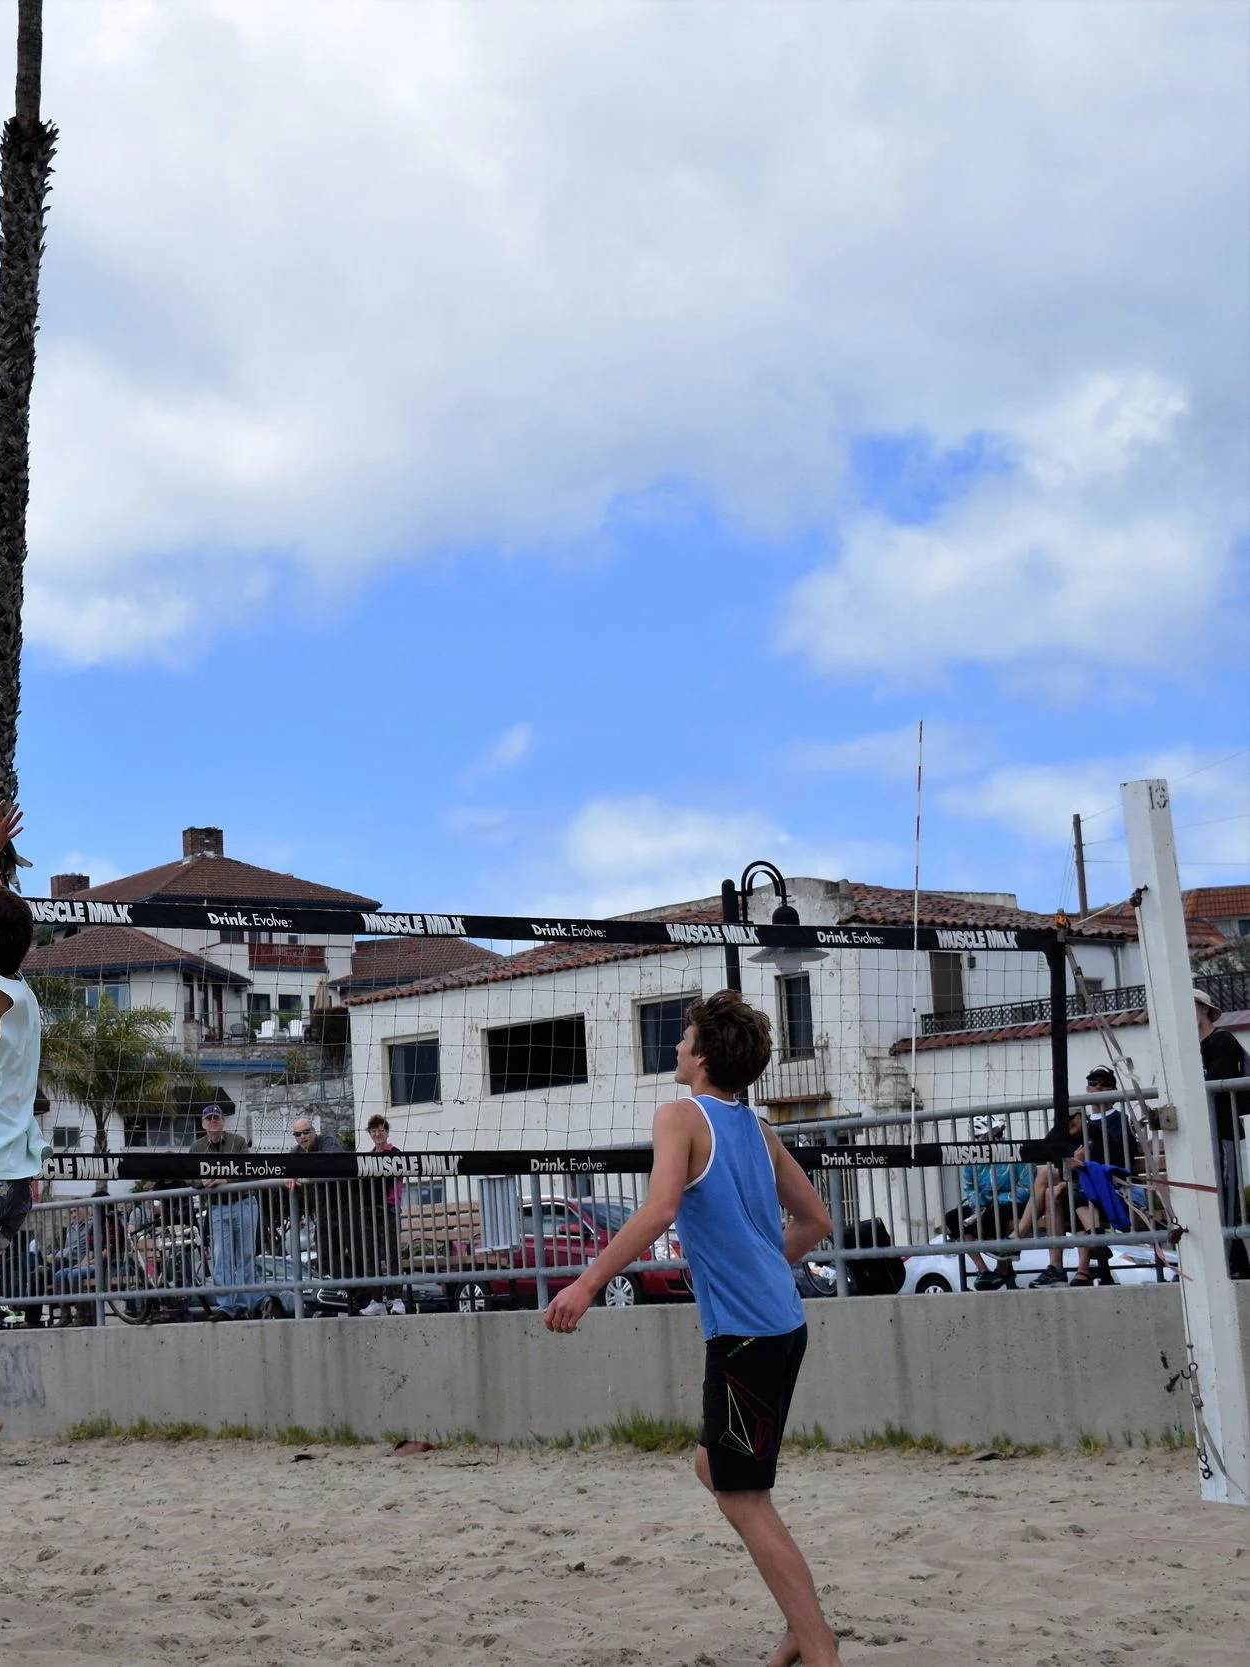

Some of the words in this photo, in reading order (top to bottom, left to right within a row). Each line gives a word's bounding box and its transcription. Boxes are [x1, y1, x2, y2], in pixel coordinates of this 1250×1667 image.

[86, 901, 133, 924] MILK
[206, 911, 252, 927] Drink.
[360, 912, 424, 935] MUSCLE
[424, 914, 466, 936] MILK
[530, 923, 570, 937] Drink.
[665, 923, 723, 944] MUSCLE
[722, 924, 759, 944] MILK
[816, 930, 852, 944] Drink.
[935, 929, 986, 949] MUSCLE
[985, 930, 1019, 949] MILK
[821, 1151, 855, 1166] Drink.
[940, 1144, 990, 1165] MUSCLE
[990, 1143, 1022, 1163] MILK
[75, 1157, 120, 1179] MILK
[199, 1160, 243, 1176] Drink.
[356, 1155, 419, 1177] MUSCLE
[420, 1154, 460, 1176] MILK
[530, 1157, 567, 1172] Drink.
